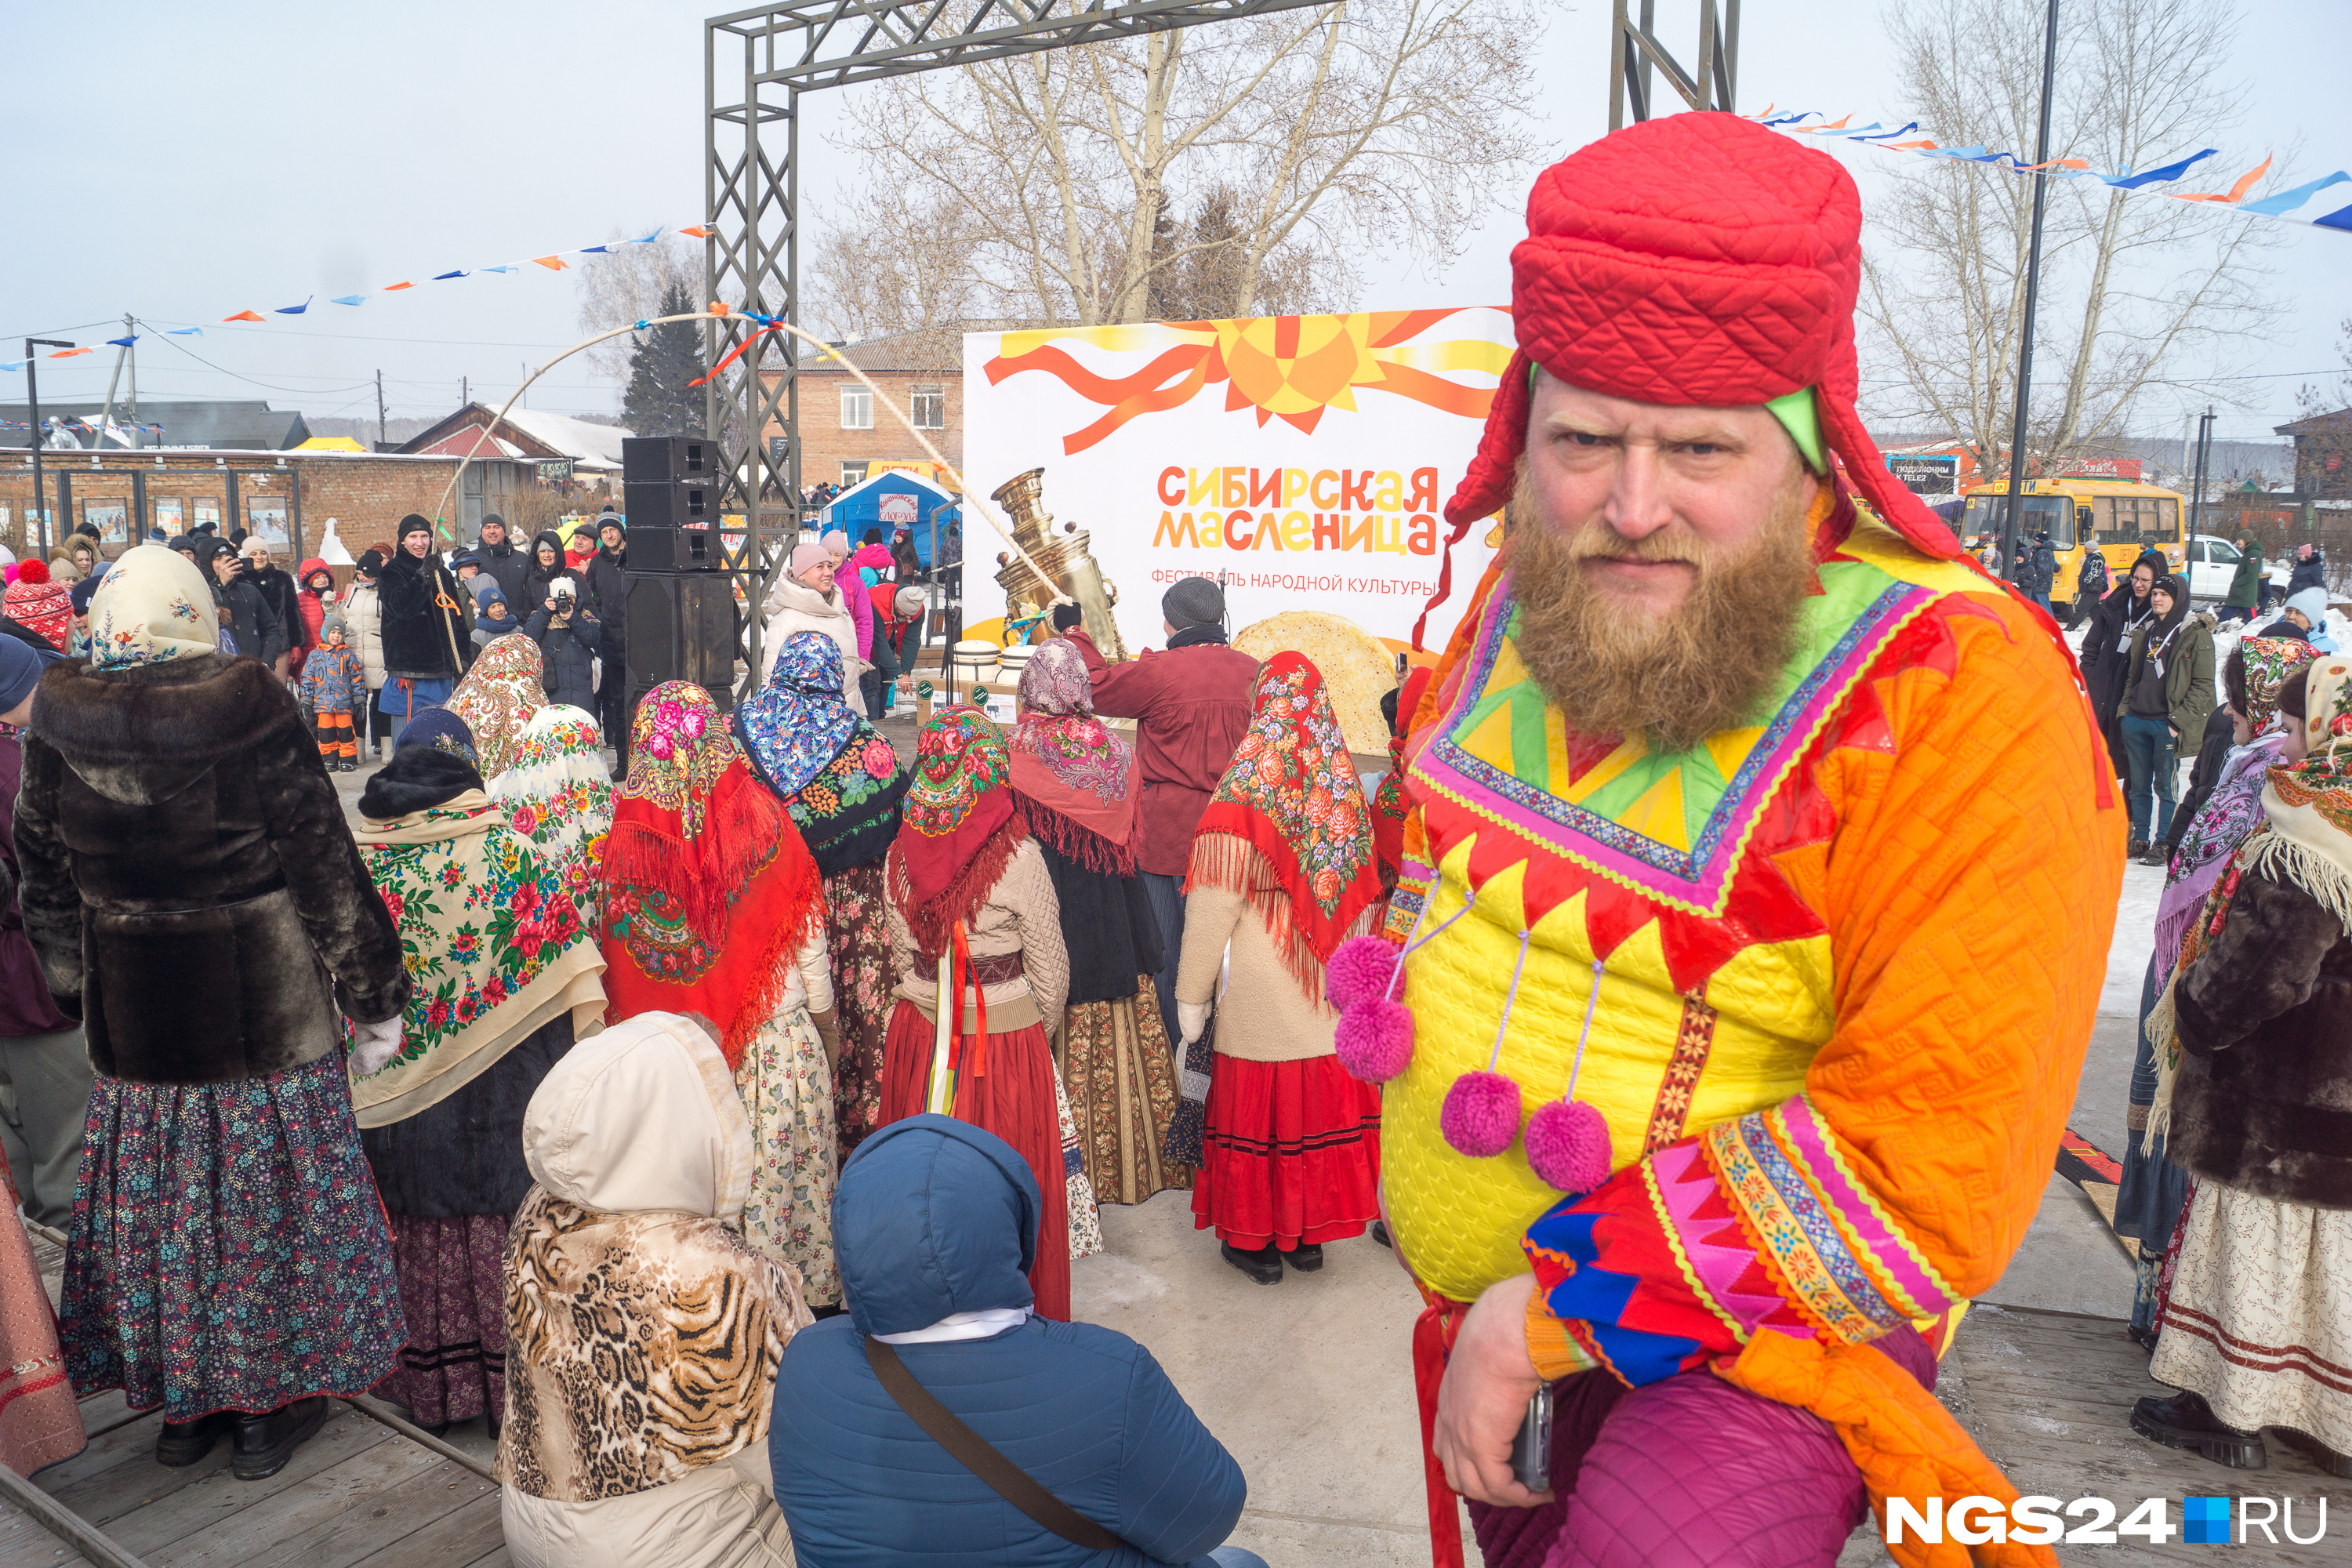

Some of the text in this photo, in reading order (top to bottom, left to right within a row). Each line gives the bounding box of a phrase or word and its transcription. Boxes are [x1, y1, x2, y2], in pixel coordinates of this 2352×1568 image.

[2007, 480, 2036, 494] ТИ
[2118, 549, 2135, 561] ДЕТИ
[1250, 574, 1343, 593] НАРОДНОЙ
[1348, 578, 1436, 596] КУЛЬТУРЫ
